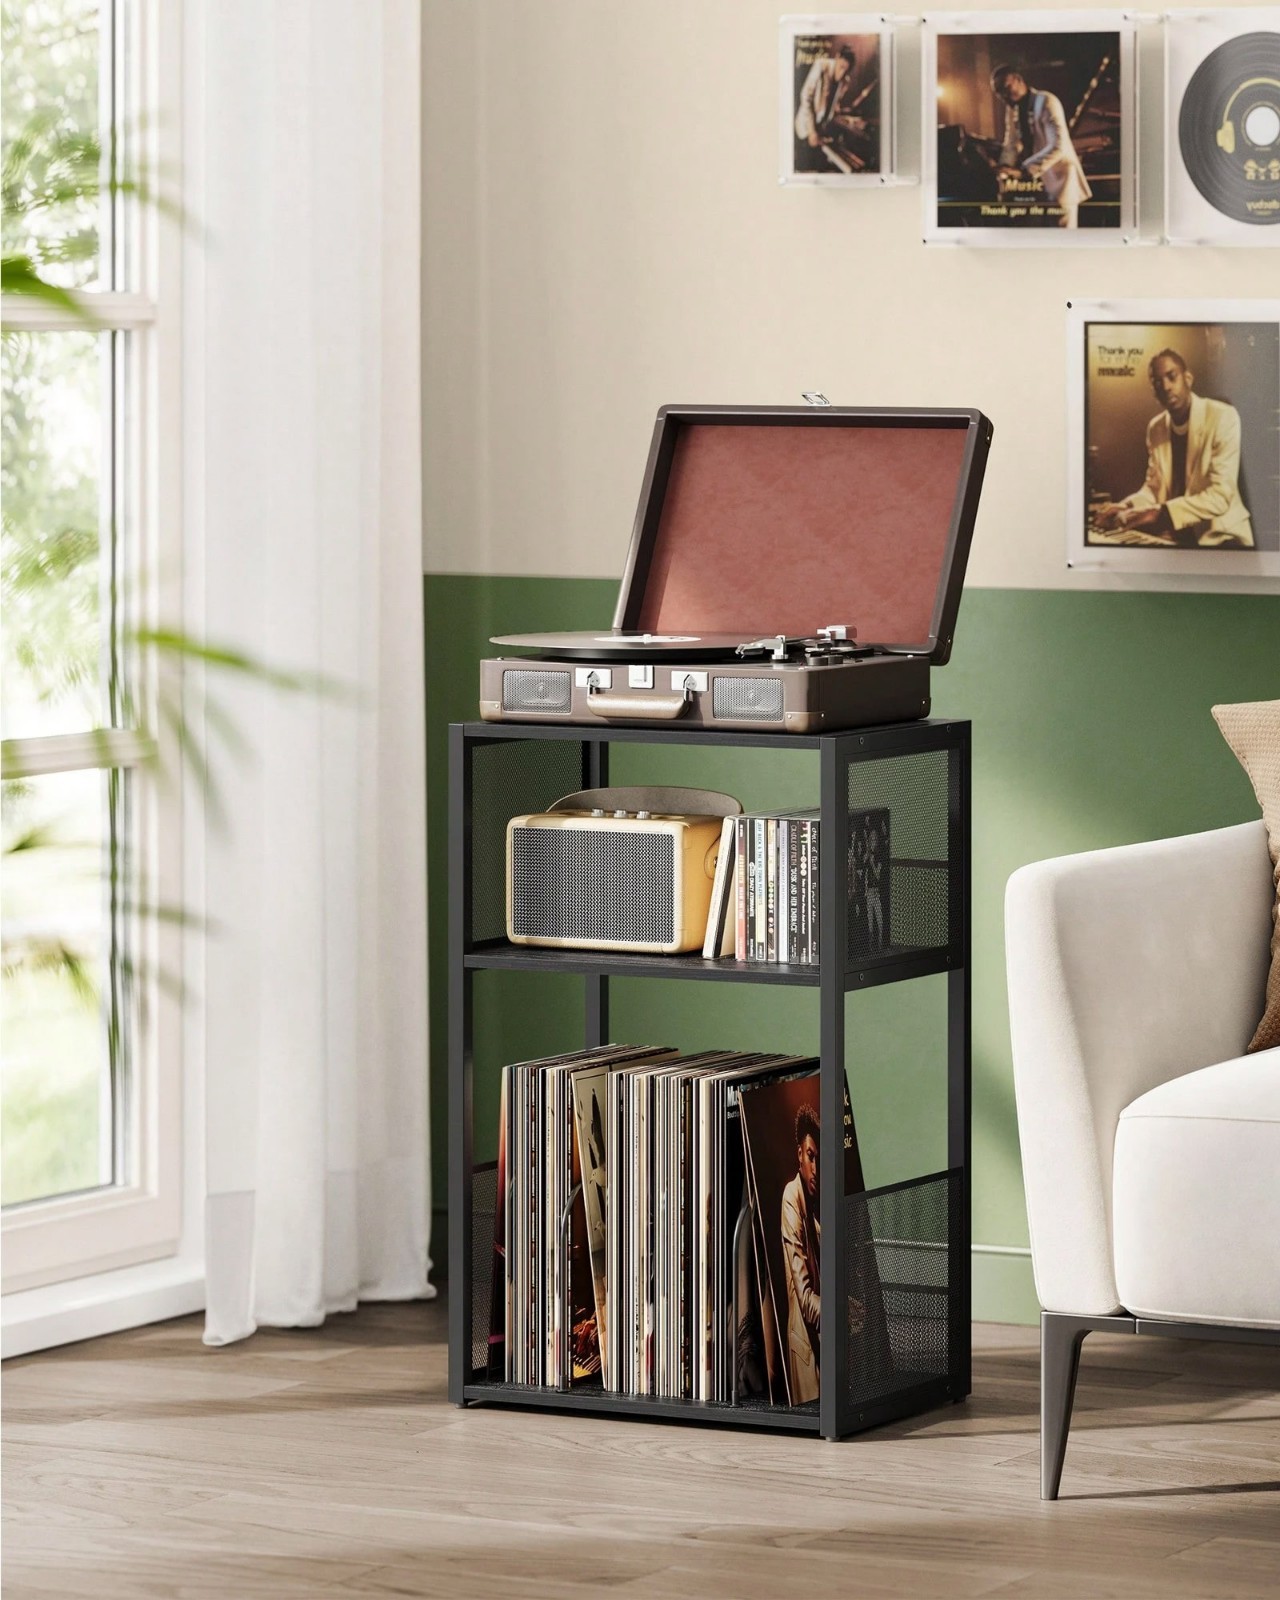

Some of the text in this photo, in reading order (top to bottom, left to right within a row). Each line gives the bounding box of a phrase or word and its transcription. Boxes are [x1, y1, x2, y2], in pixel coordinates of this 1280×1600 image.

[1005, 179, 1043, 192] Music
[981, 204, 1008, 216] Thank
[1010, 207, 1027, 218] you
[1029, 204, 1045, 216] the
[1097, 345, 1144, 358] Thank you
[1097, 365, 1136, 377] music
[790, 884, 798, 895] AND
[790, 896, 798, 907] HER
[843, 1133, 852, 1148] sic
